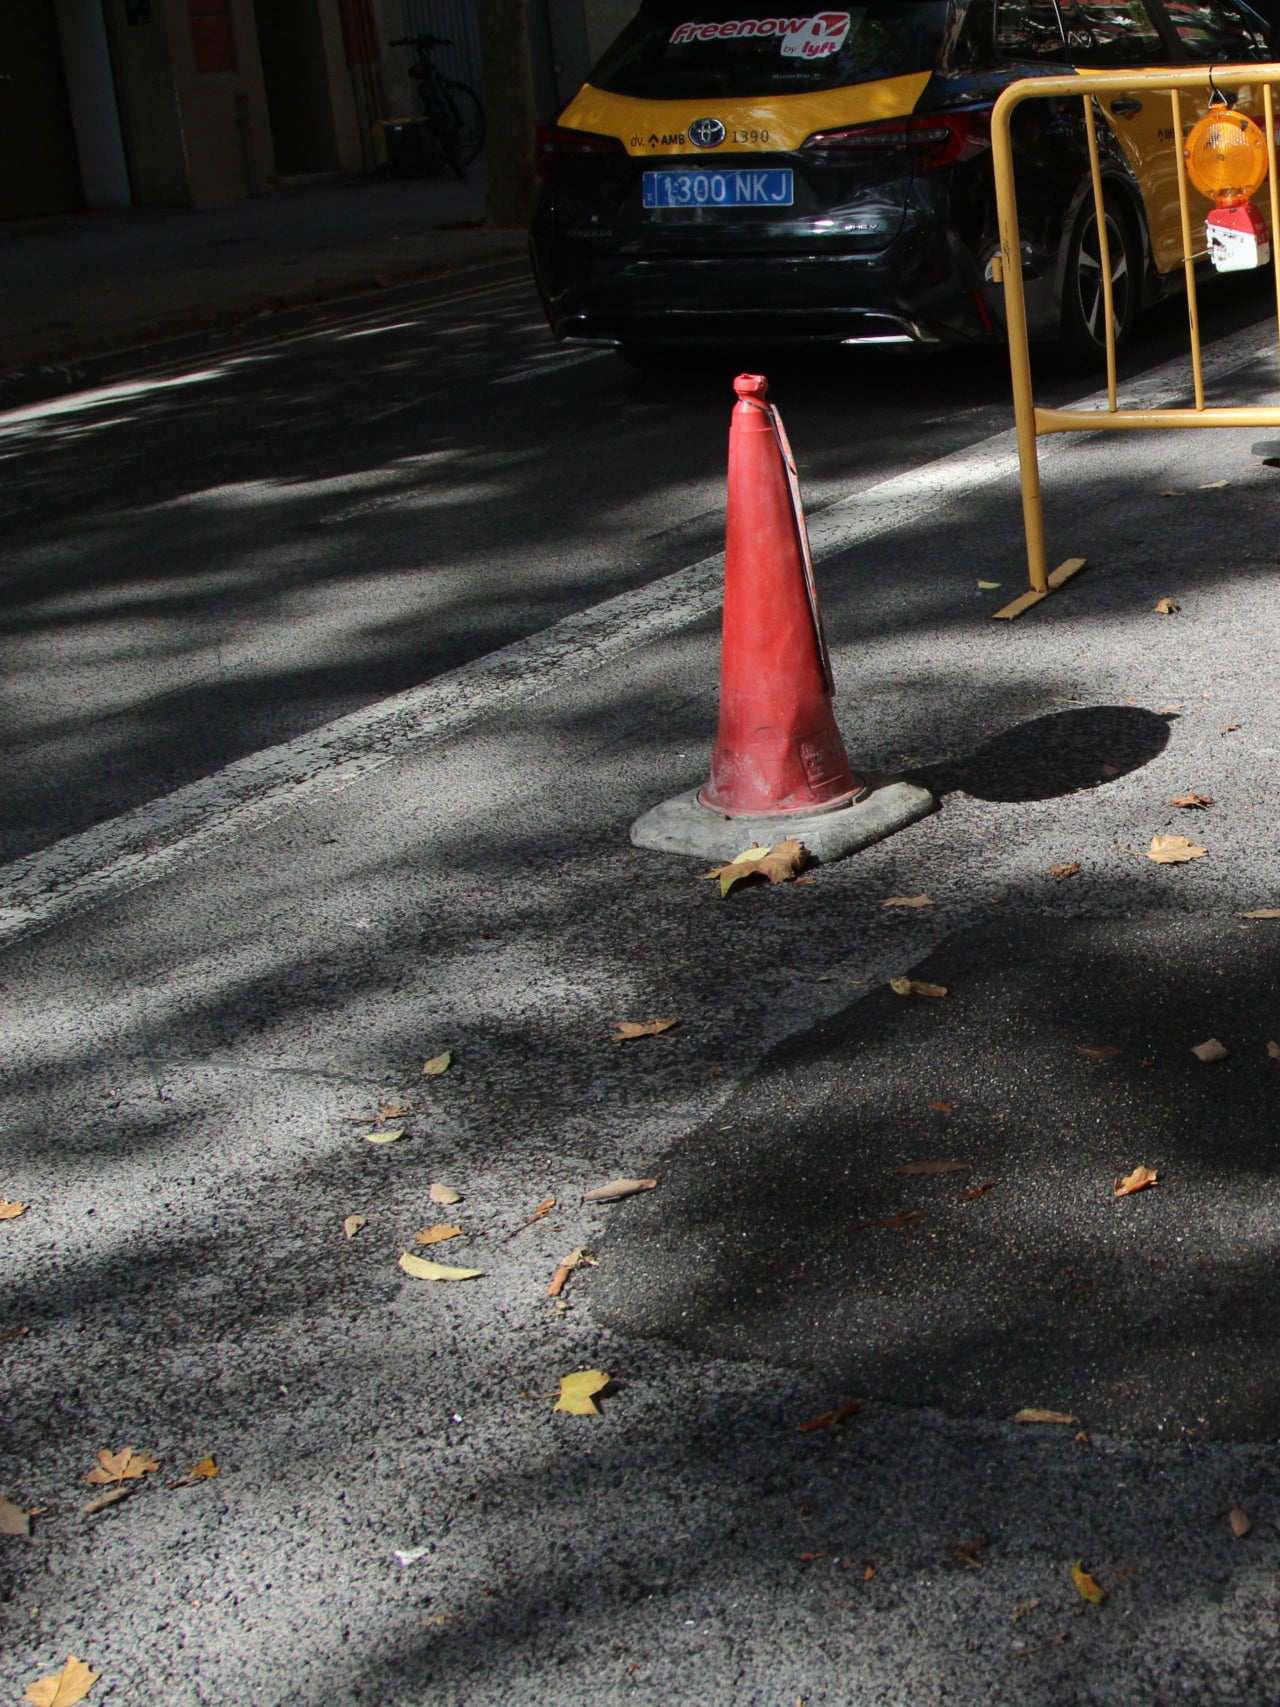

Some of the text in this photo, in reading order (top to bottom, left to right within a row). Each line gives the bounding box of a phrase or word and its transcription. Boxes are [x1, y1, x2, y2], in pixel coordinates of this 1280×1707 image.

[671, 19, 808, 43] freenow
[783, 41, 837, 56] by lyft
[631, 130, 769, 147] dv. AMB 1390
[665, 176, 726, 203] 1300
[735, 174, 787, 201] NKJ
